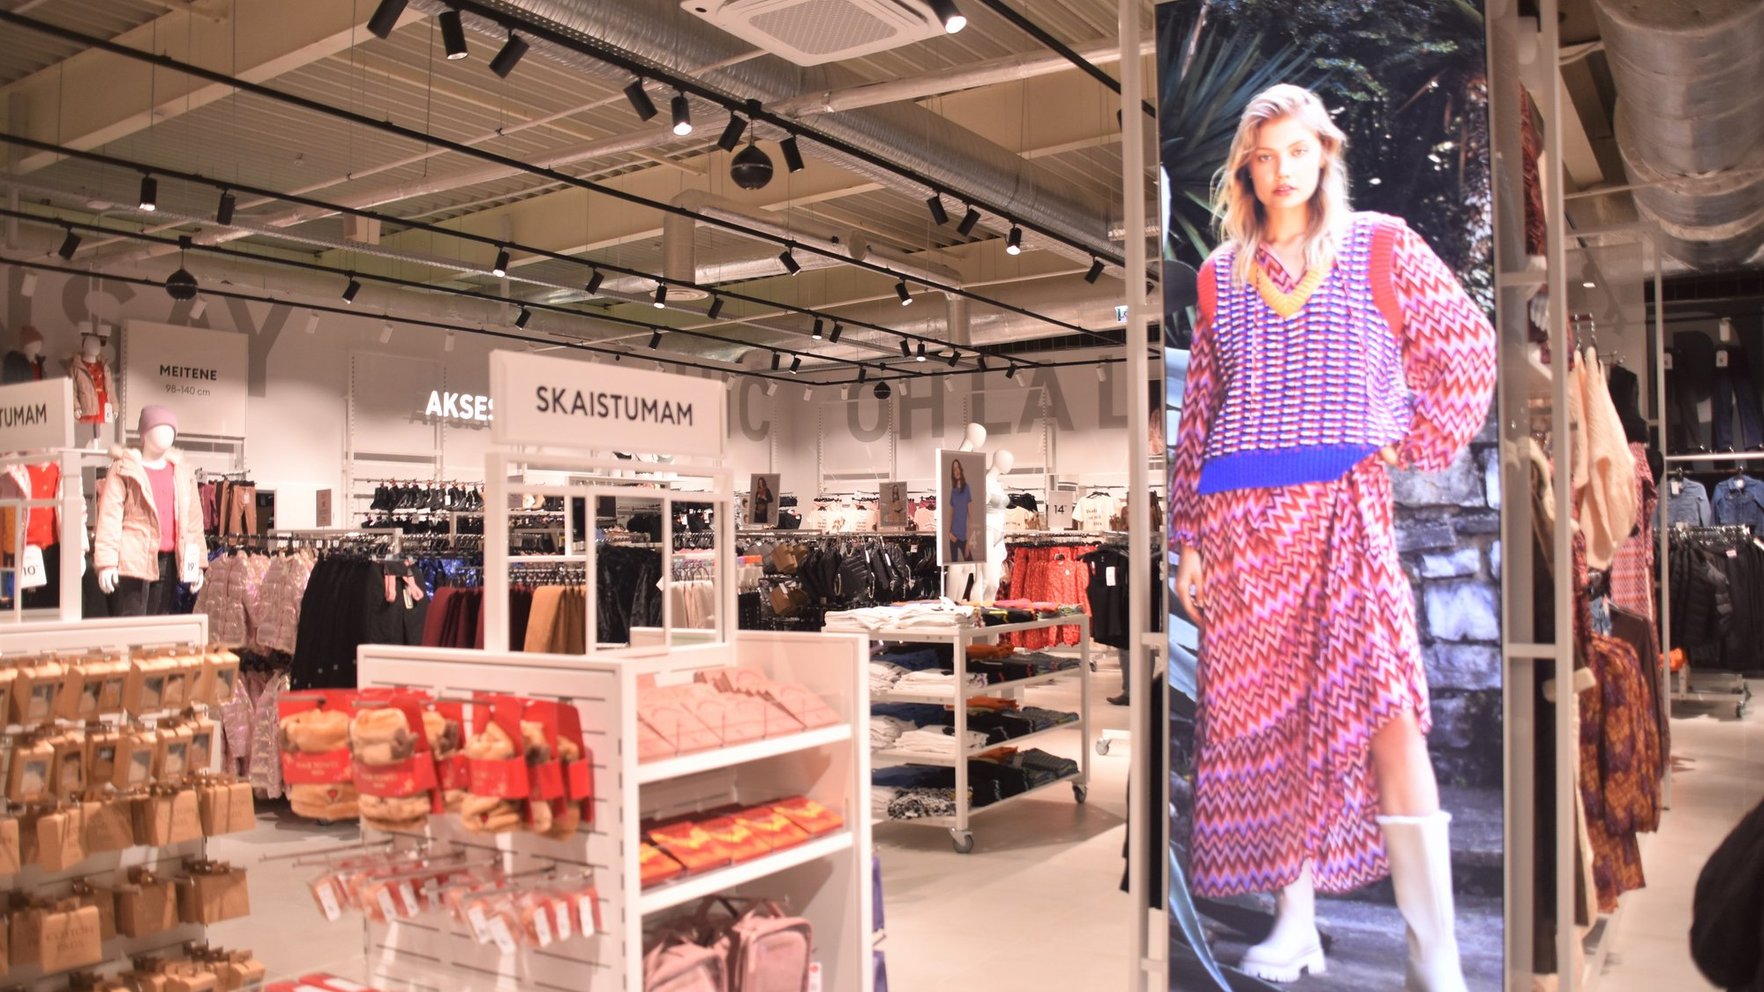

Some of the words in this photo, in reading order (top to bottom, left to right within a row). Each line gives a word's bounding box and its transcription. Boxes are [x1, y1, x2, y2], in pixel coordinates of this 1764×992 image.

[160, 364, 217, 381] MEITENE
[197, 388, 211, 396] cm
[536, 385, 694, 427] SKAISTUMAM
[1098, 354, 1128, 430] L
